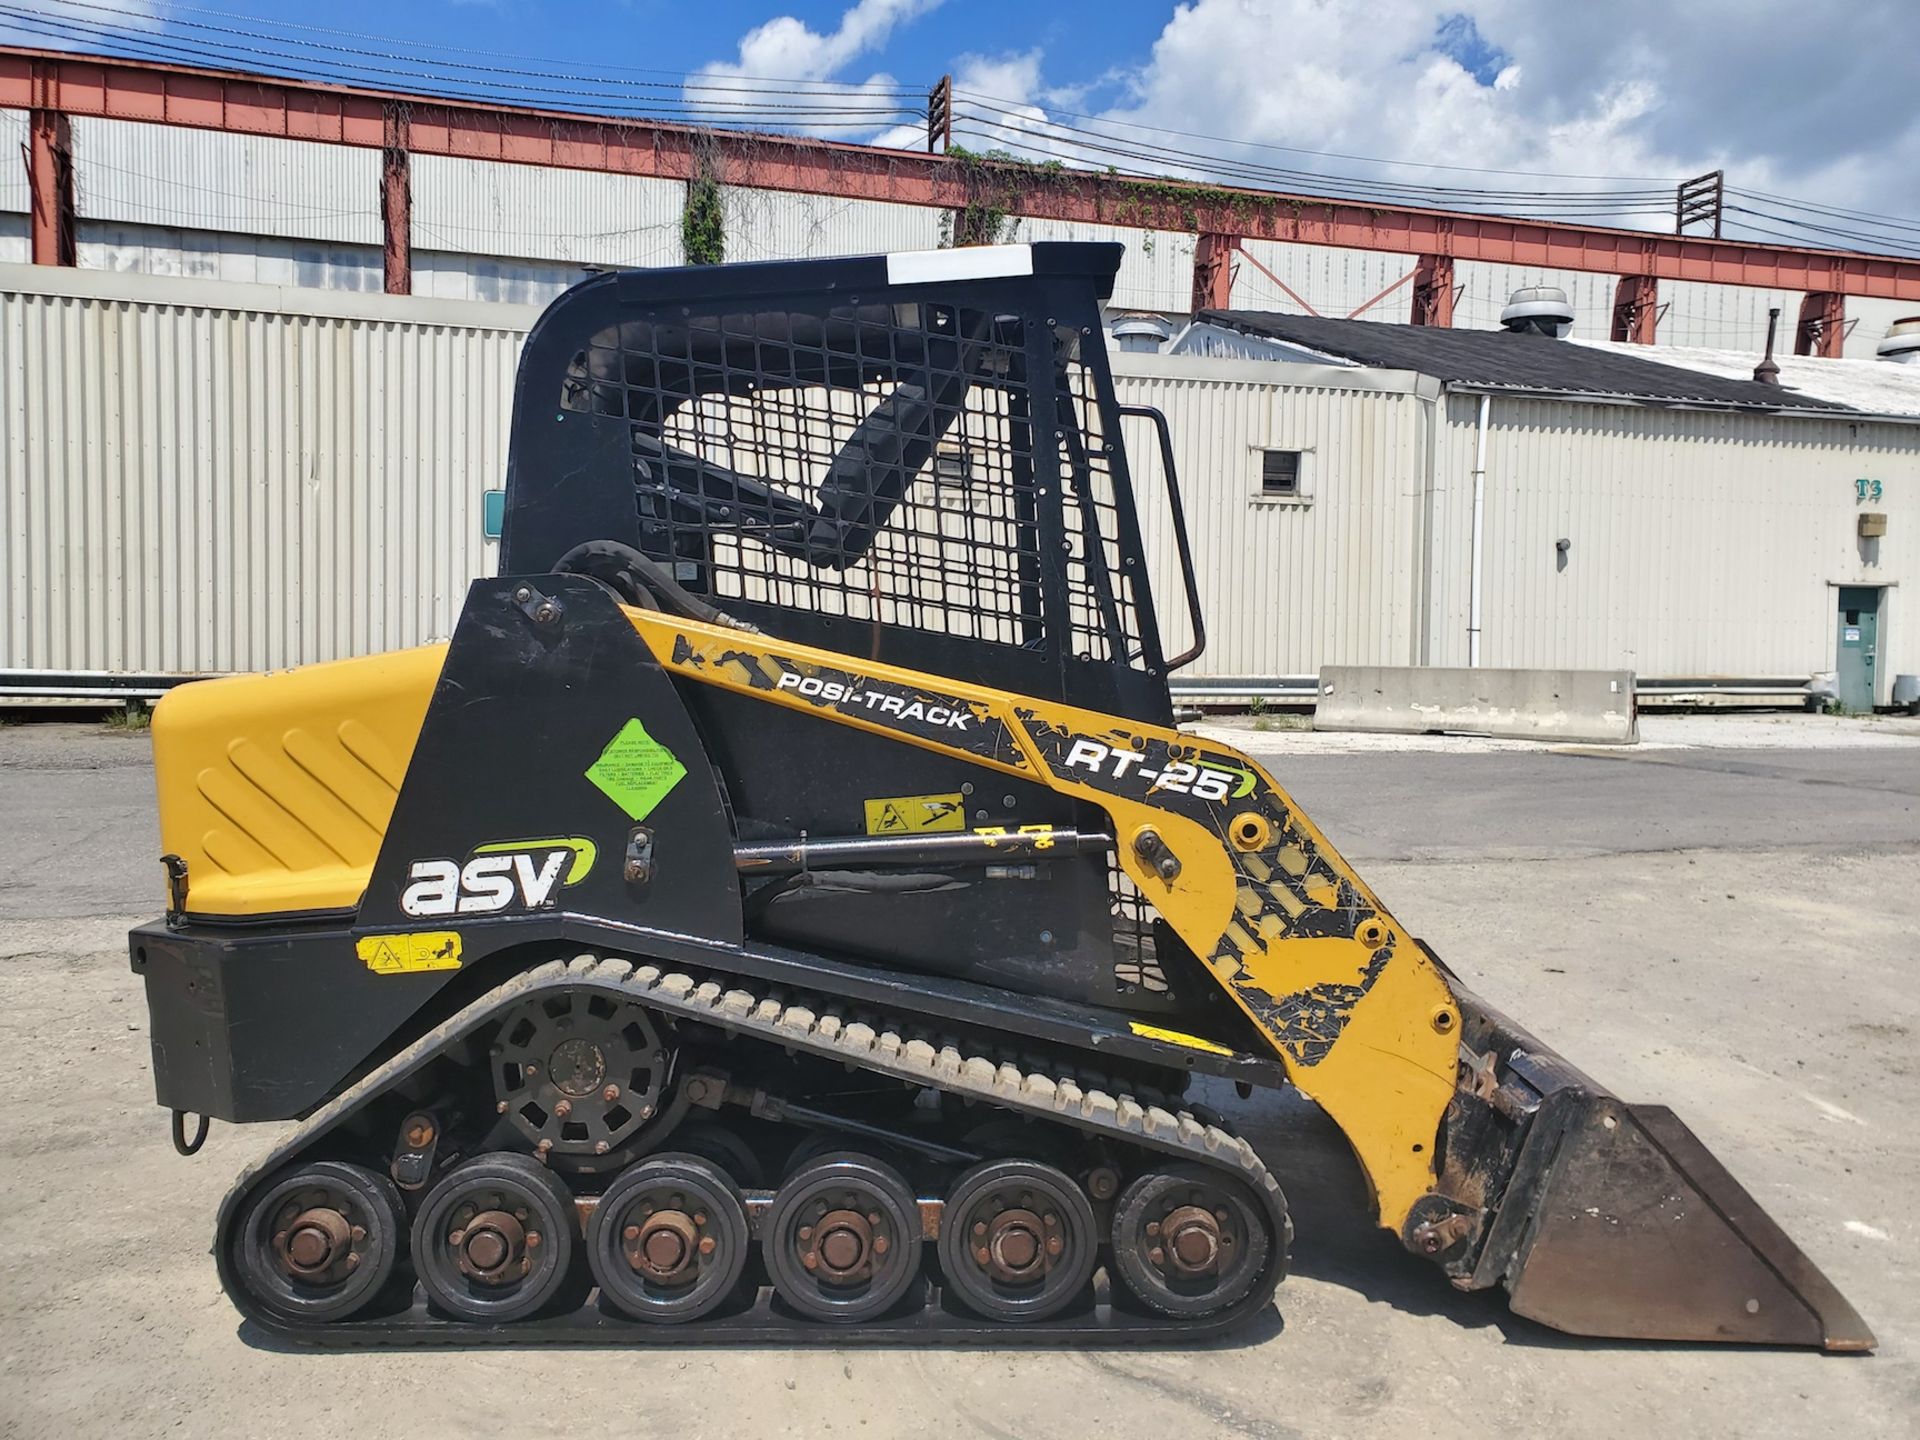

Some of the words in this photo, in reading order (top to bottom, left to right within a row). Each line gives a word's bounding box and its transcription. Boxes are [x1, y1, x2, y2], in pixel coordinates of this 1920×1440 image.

[1856, 479, 1882, 499] T3
[777, 671, 973, 730] POSI-TRACK
[1064, 739, 1234, 800] RT-25
